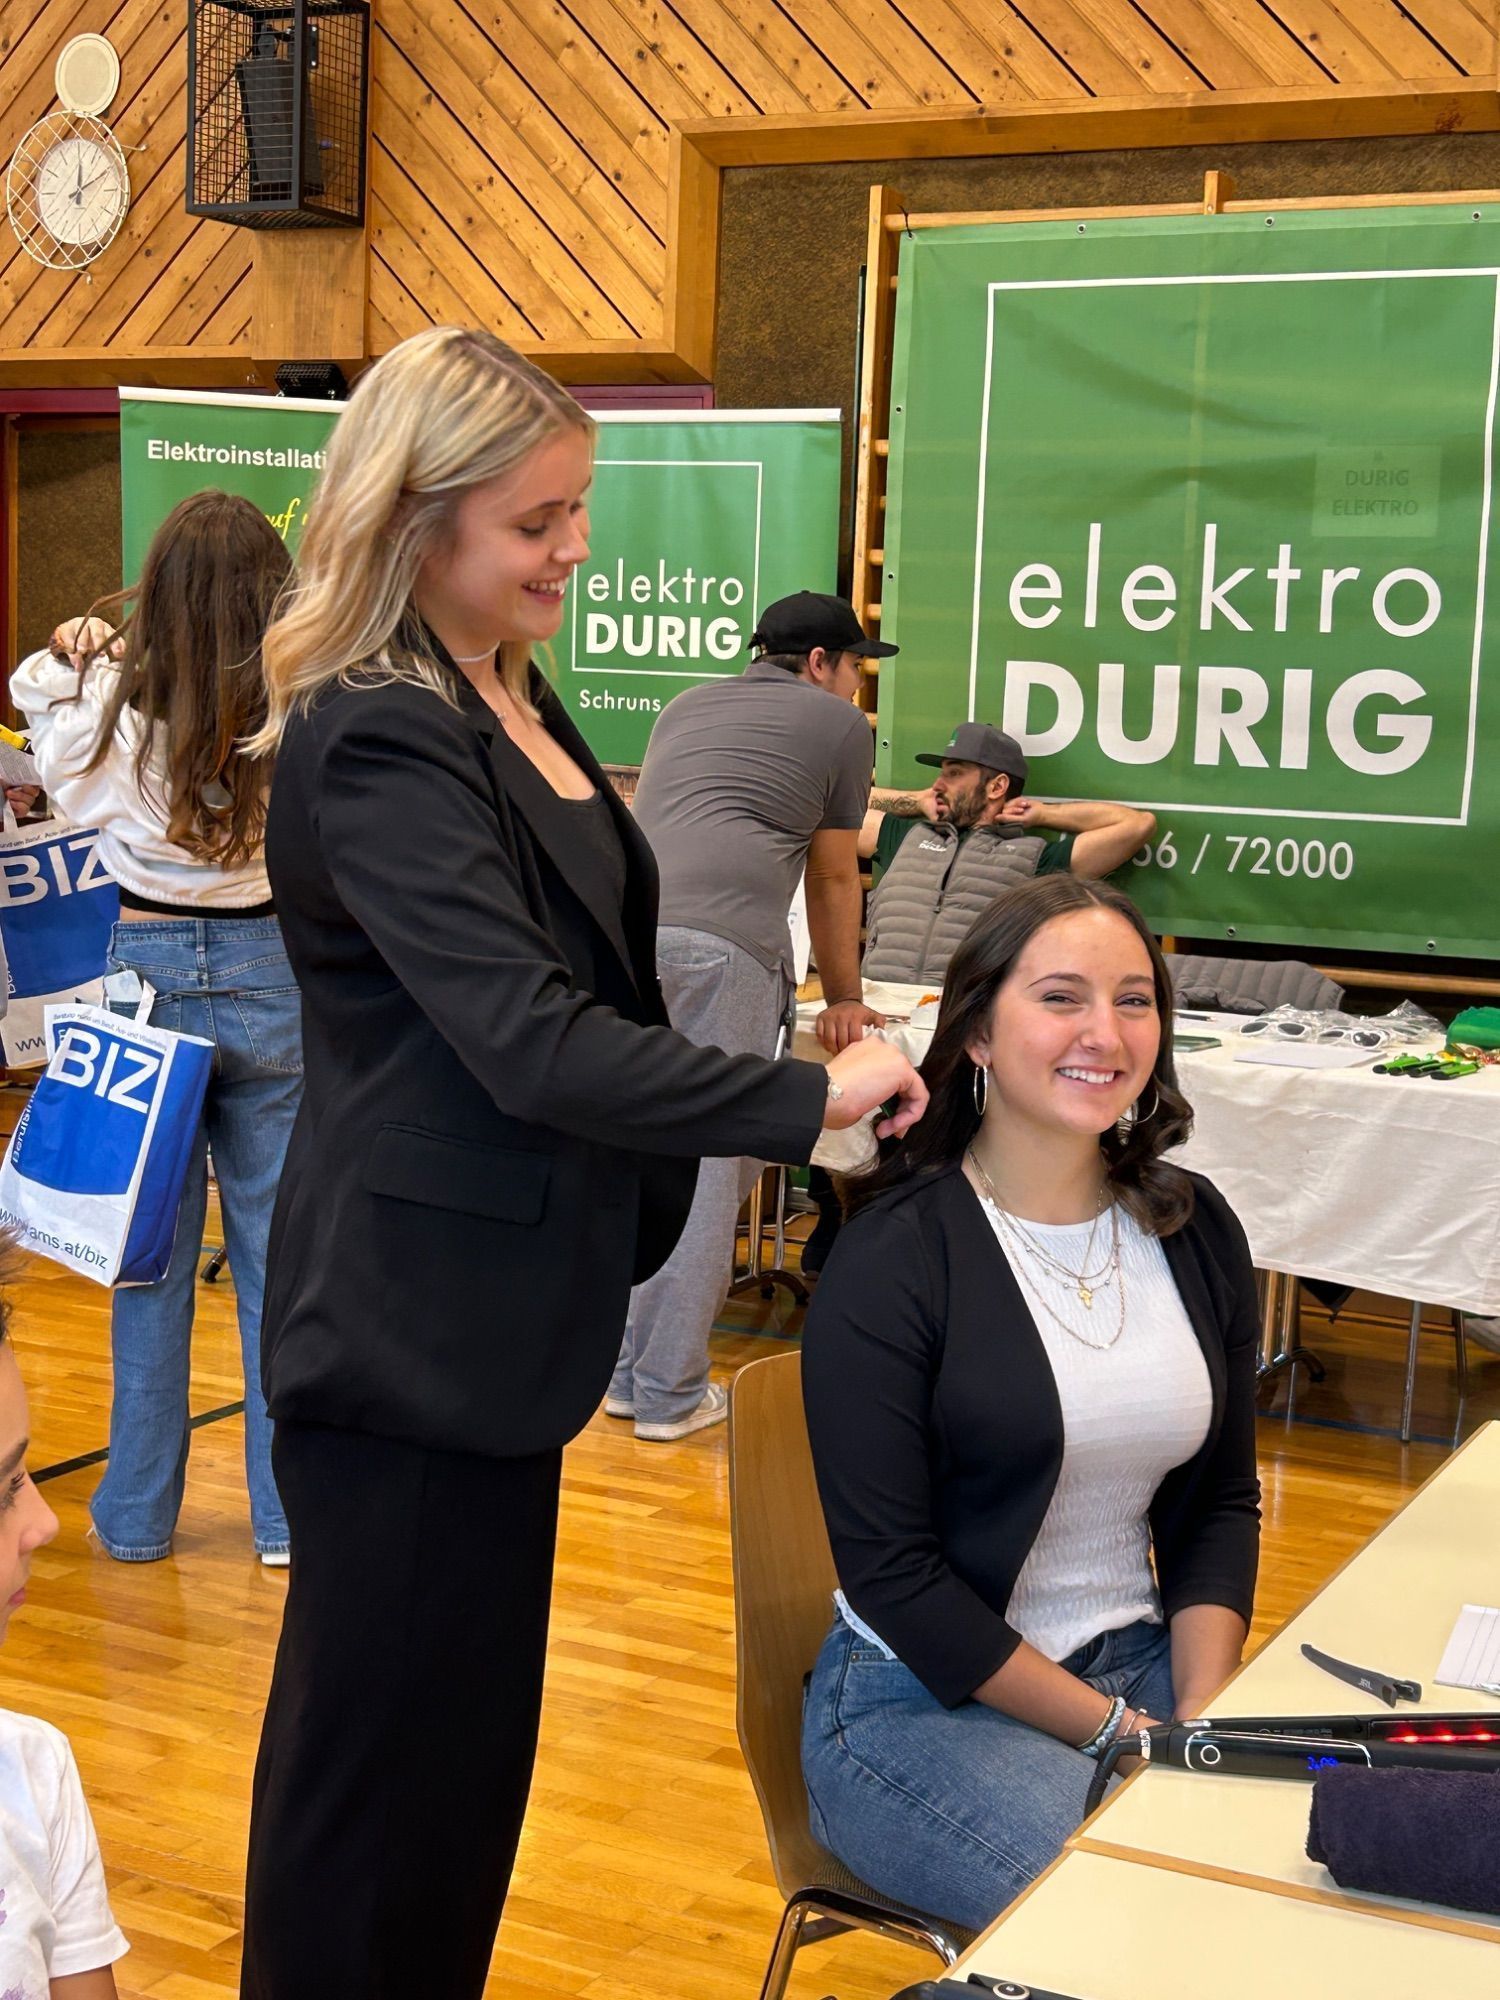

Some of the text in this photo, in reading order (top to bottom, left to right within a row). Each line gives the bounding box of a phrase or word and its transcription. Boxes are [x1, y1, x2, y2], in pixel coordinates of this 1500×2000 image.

[1345, 470, 1408, 487] DURIG
[265, 497, 301, 540] uf
[1332, 499, 1419, 516] ELEKTRO
[587, 558, 744, 606] elektro
[1009, 523, 1442, 637] elektro
[586, 613, 742, 660] DURIG
[579, 689, 662, 712] Schruns
[1002, 660, 1433, 776] DURIG
[0, 834, 118, 908] BIZ
[1190, 833, 1211, 875] /
[1225, 836, 1354, 880] 72000
[46, 1028, 160, 1114] BIZ
